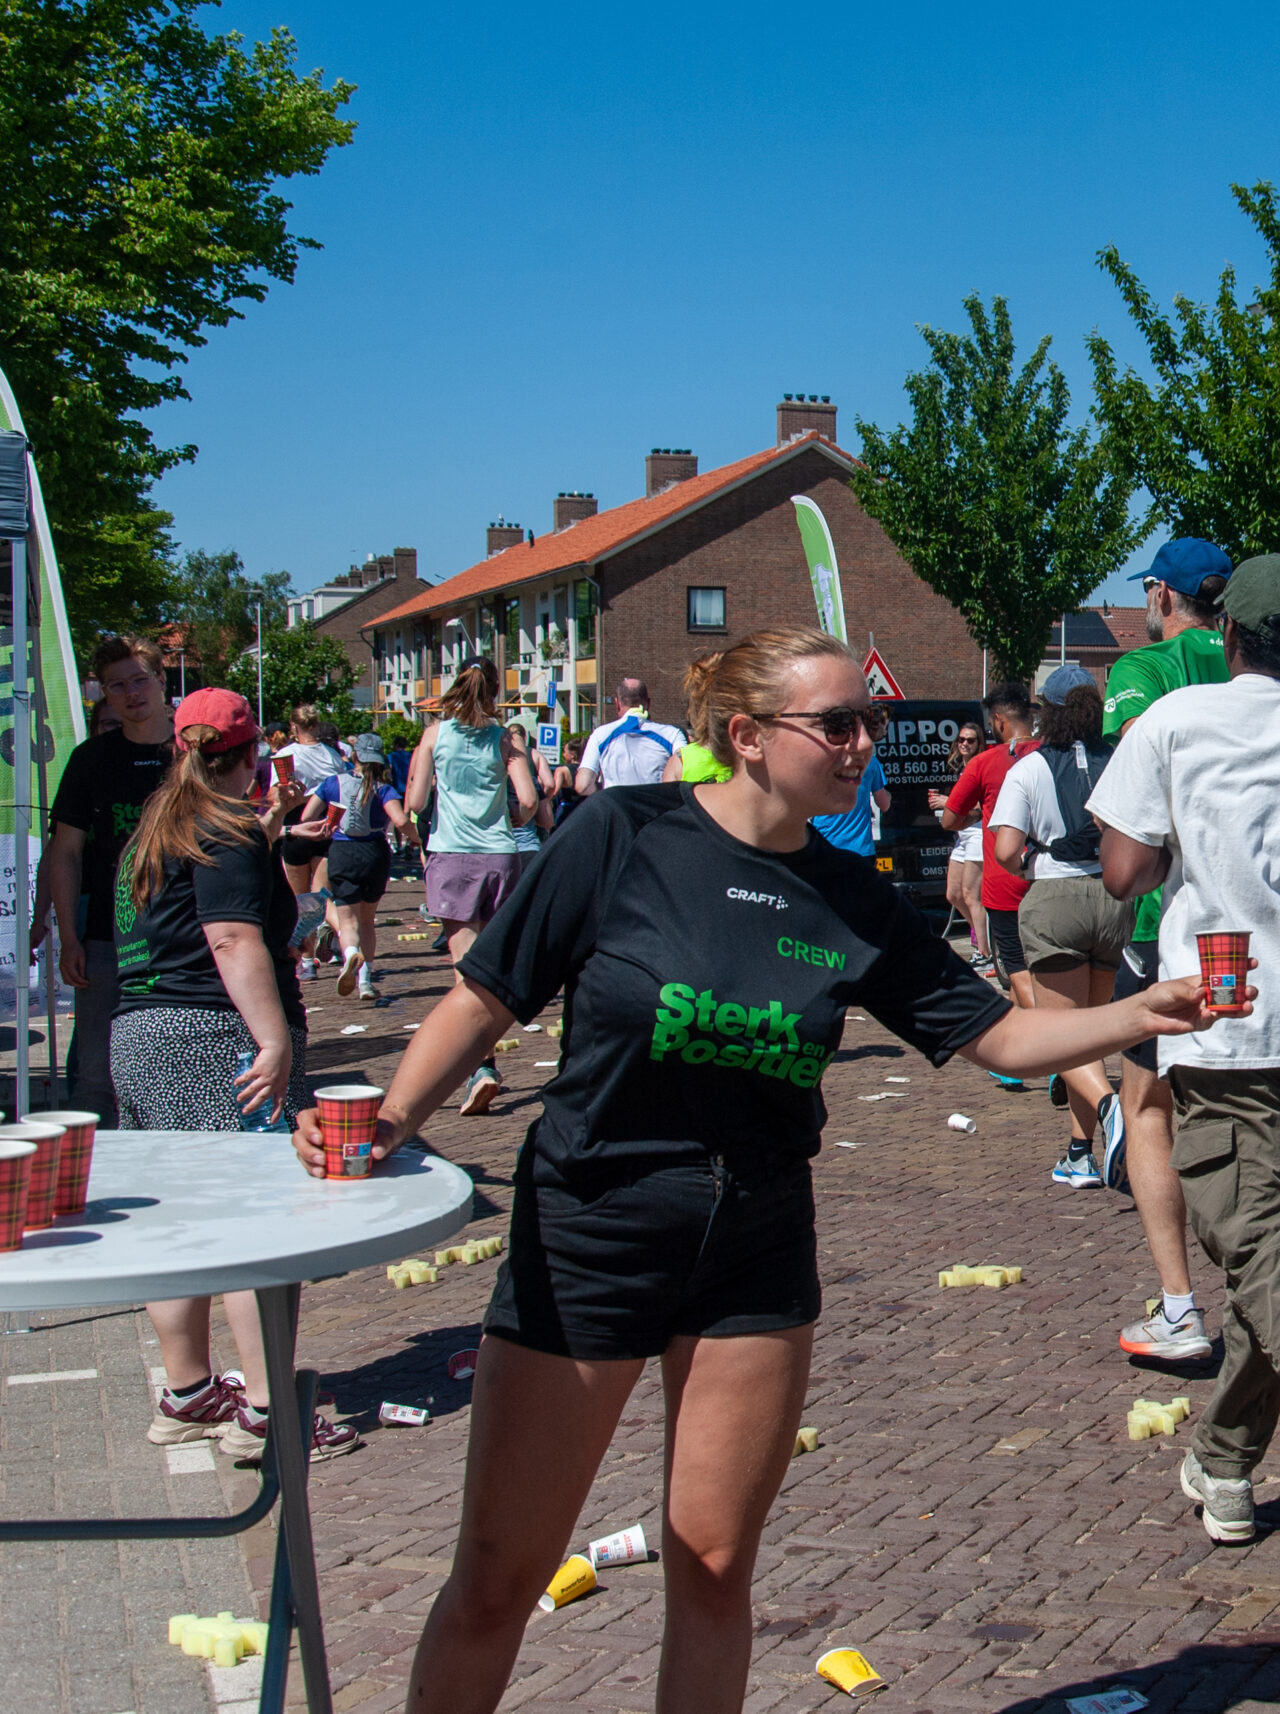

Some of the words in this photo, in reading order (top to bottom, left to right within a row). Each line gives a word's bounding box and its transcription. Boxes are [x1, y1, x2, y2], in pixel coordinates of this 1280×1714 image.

[543, 728, 555, 744] P
[880, 719, 959, 744] IPPO
[875, 743, 951, 757] CADOORS
[881, 761, 900, 775] 38
[904, 760, 928, 775] 560
[931, 760, 946, 773] 51
[111, 802, 145, 820] Ste
[922, 866, 949, 877] OMST
[726, 887, 777, 907] CRAFT
[776, 936, 847, 971] CREW
[655, 982, 803, 1047] Sterk
[649, 1021, 836, 1089] Positief
[802, 1041, 826, 1058] en
